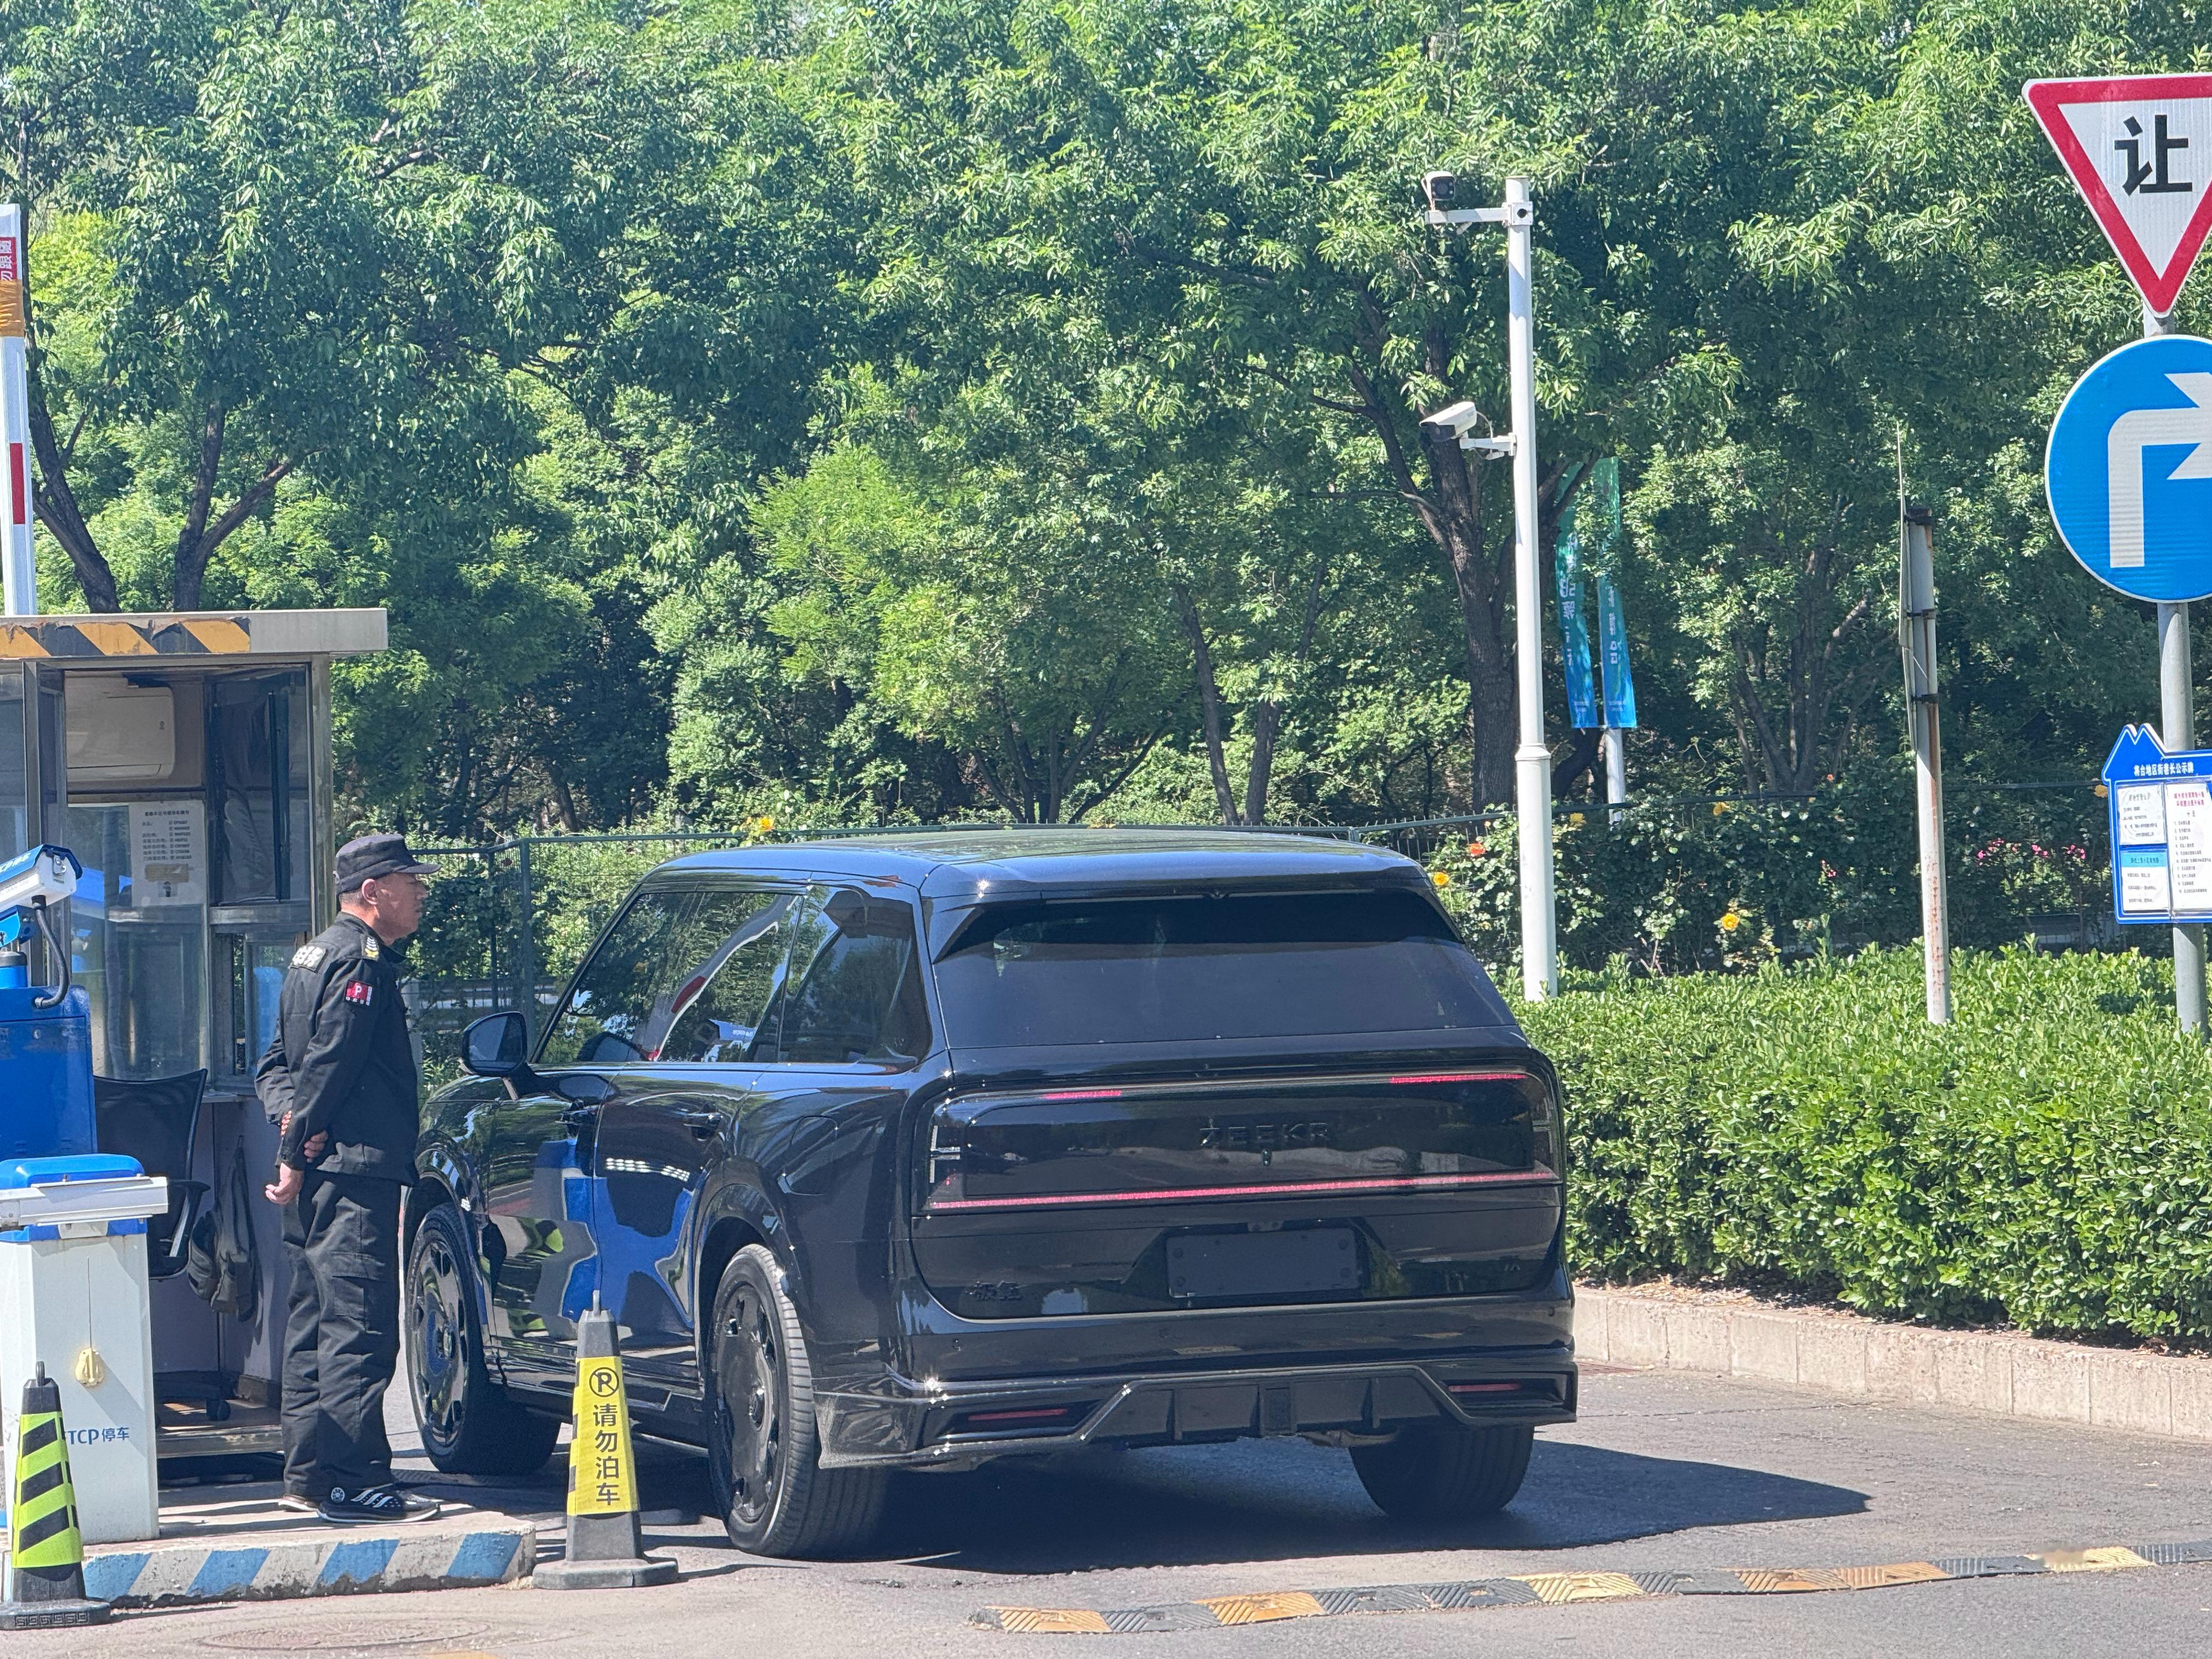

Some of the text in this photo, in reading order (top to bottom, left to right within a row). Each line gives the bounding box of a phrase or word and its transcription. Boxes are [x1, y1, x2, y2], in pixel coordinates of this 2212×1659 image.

[2114, 115, 2193, 197] 让
[1200, 1122, 1329, 1146] ZEEKR
[65, 1427, 129, 1445] TCP 停车
[593, 1403, 620, 1506] 请勿泊车
